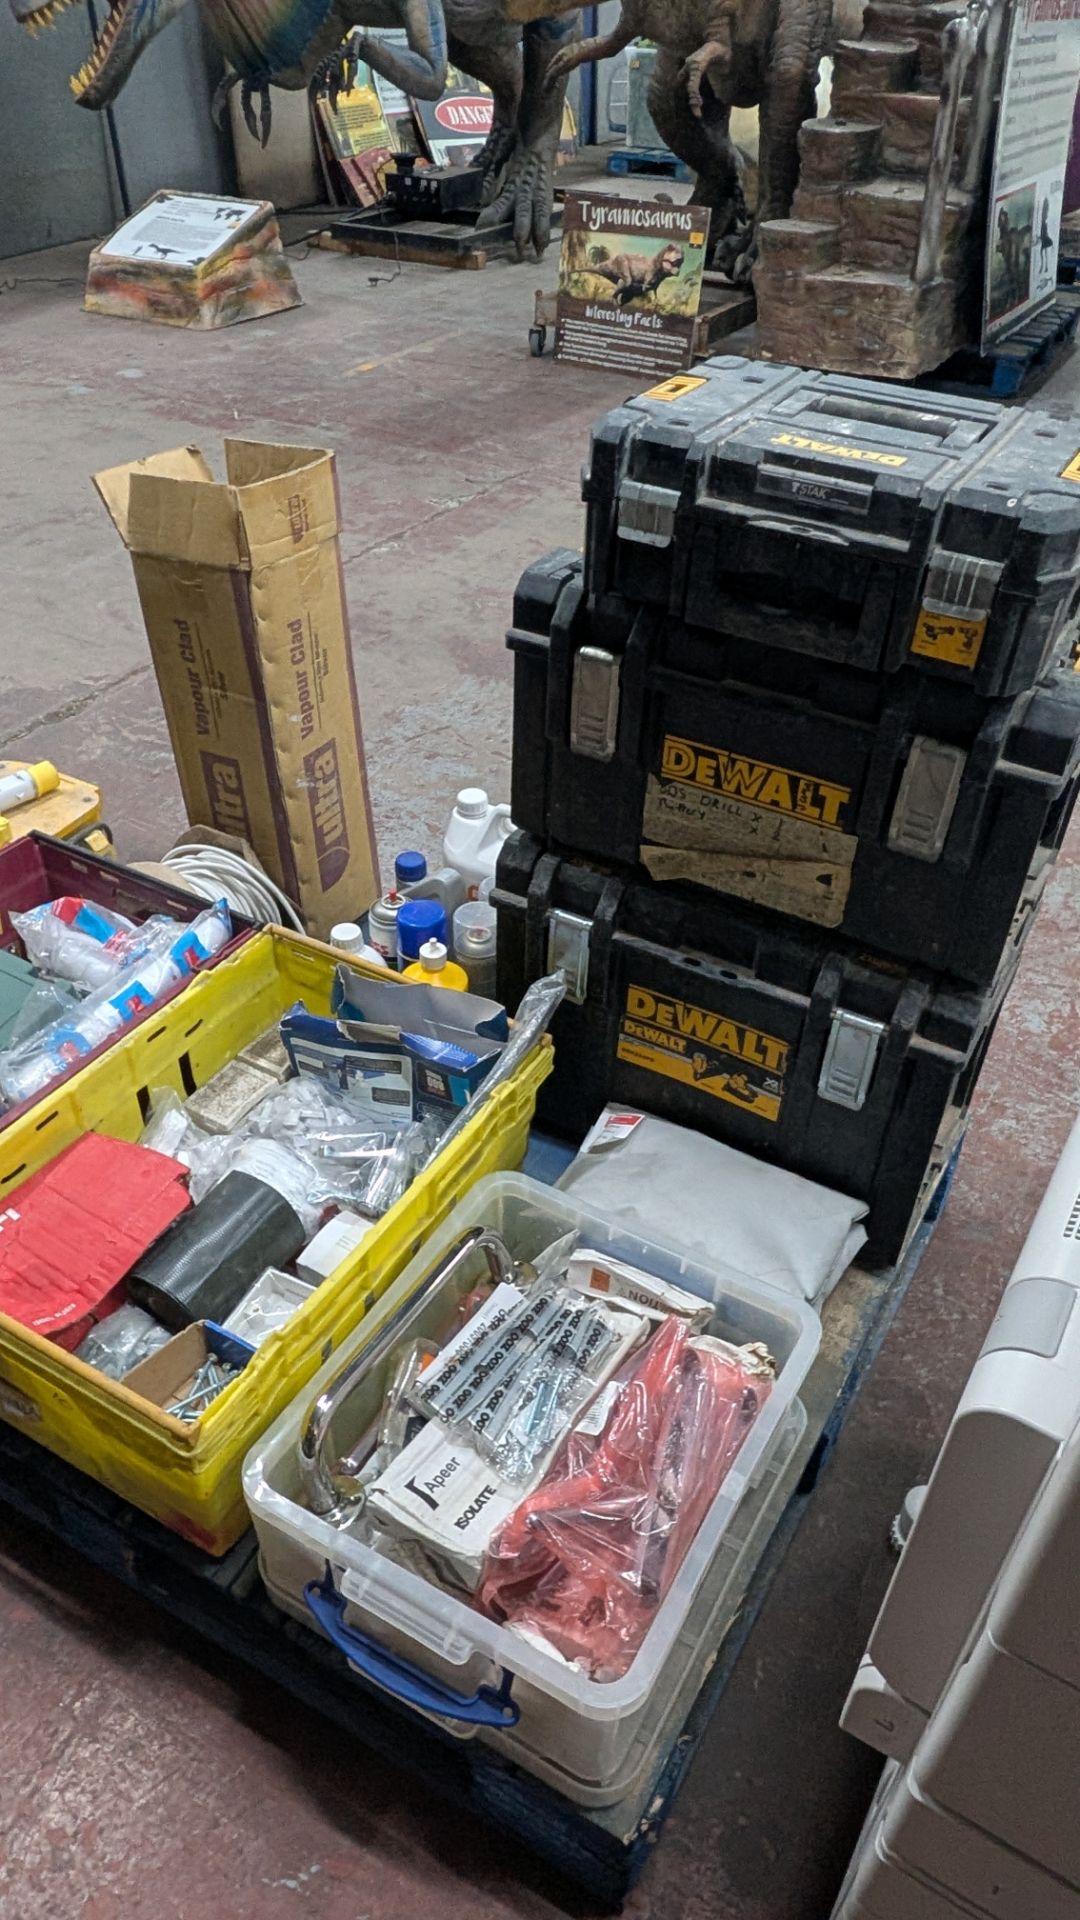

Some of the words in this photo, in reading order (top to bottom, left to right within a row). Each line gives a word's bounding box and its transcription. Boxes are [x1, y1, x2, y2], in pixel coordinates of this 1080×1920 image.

[446, 105, 493, 125] DANGE
[577, 200, 692, 231] Tyrannosaurus
[585, 305, 633, 328] Interesting
[174, 619, 196, 664] Clad
[287, 618, 305, 666] Clad
[187, 668, 210, 735] Vapour
[296, 669, 315, 740] Vapour
[212, 761, 249, 838] ltra
[314, 749, 344, 846] ultra
[662, 739, 850, 826] DEWALT
[700, 795, 742, 817] DRILL
[624, 1020, 687, 1053] DEWALT
[626, 987, 787, 1070] DEWALT
[424, 1457, 461, 1493] Apeer
[453, 1484, 497, 1530] ISOLATE
